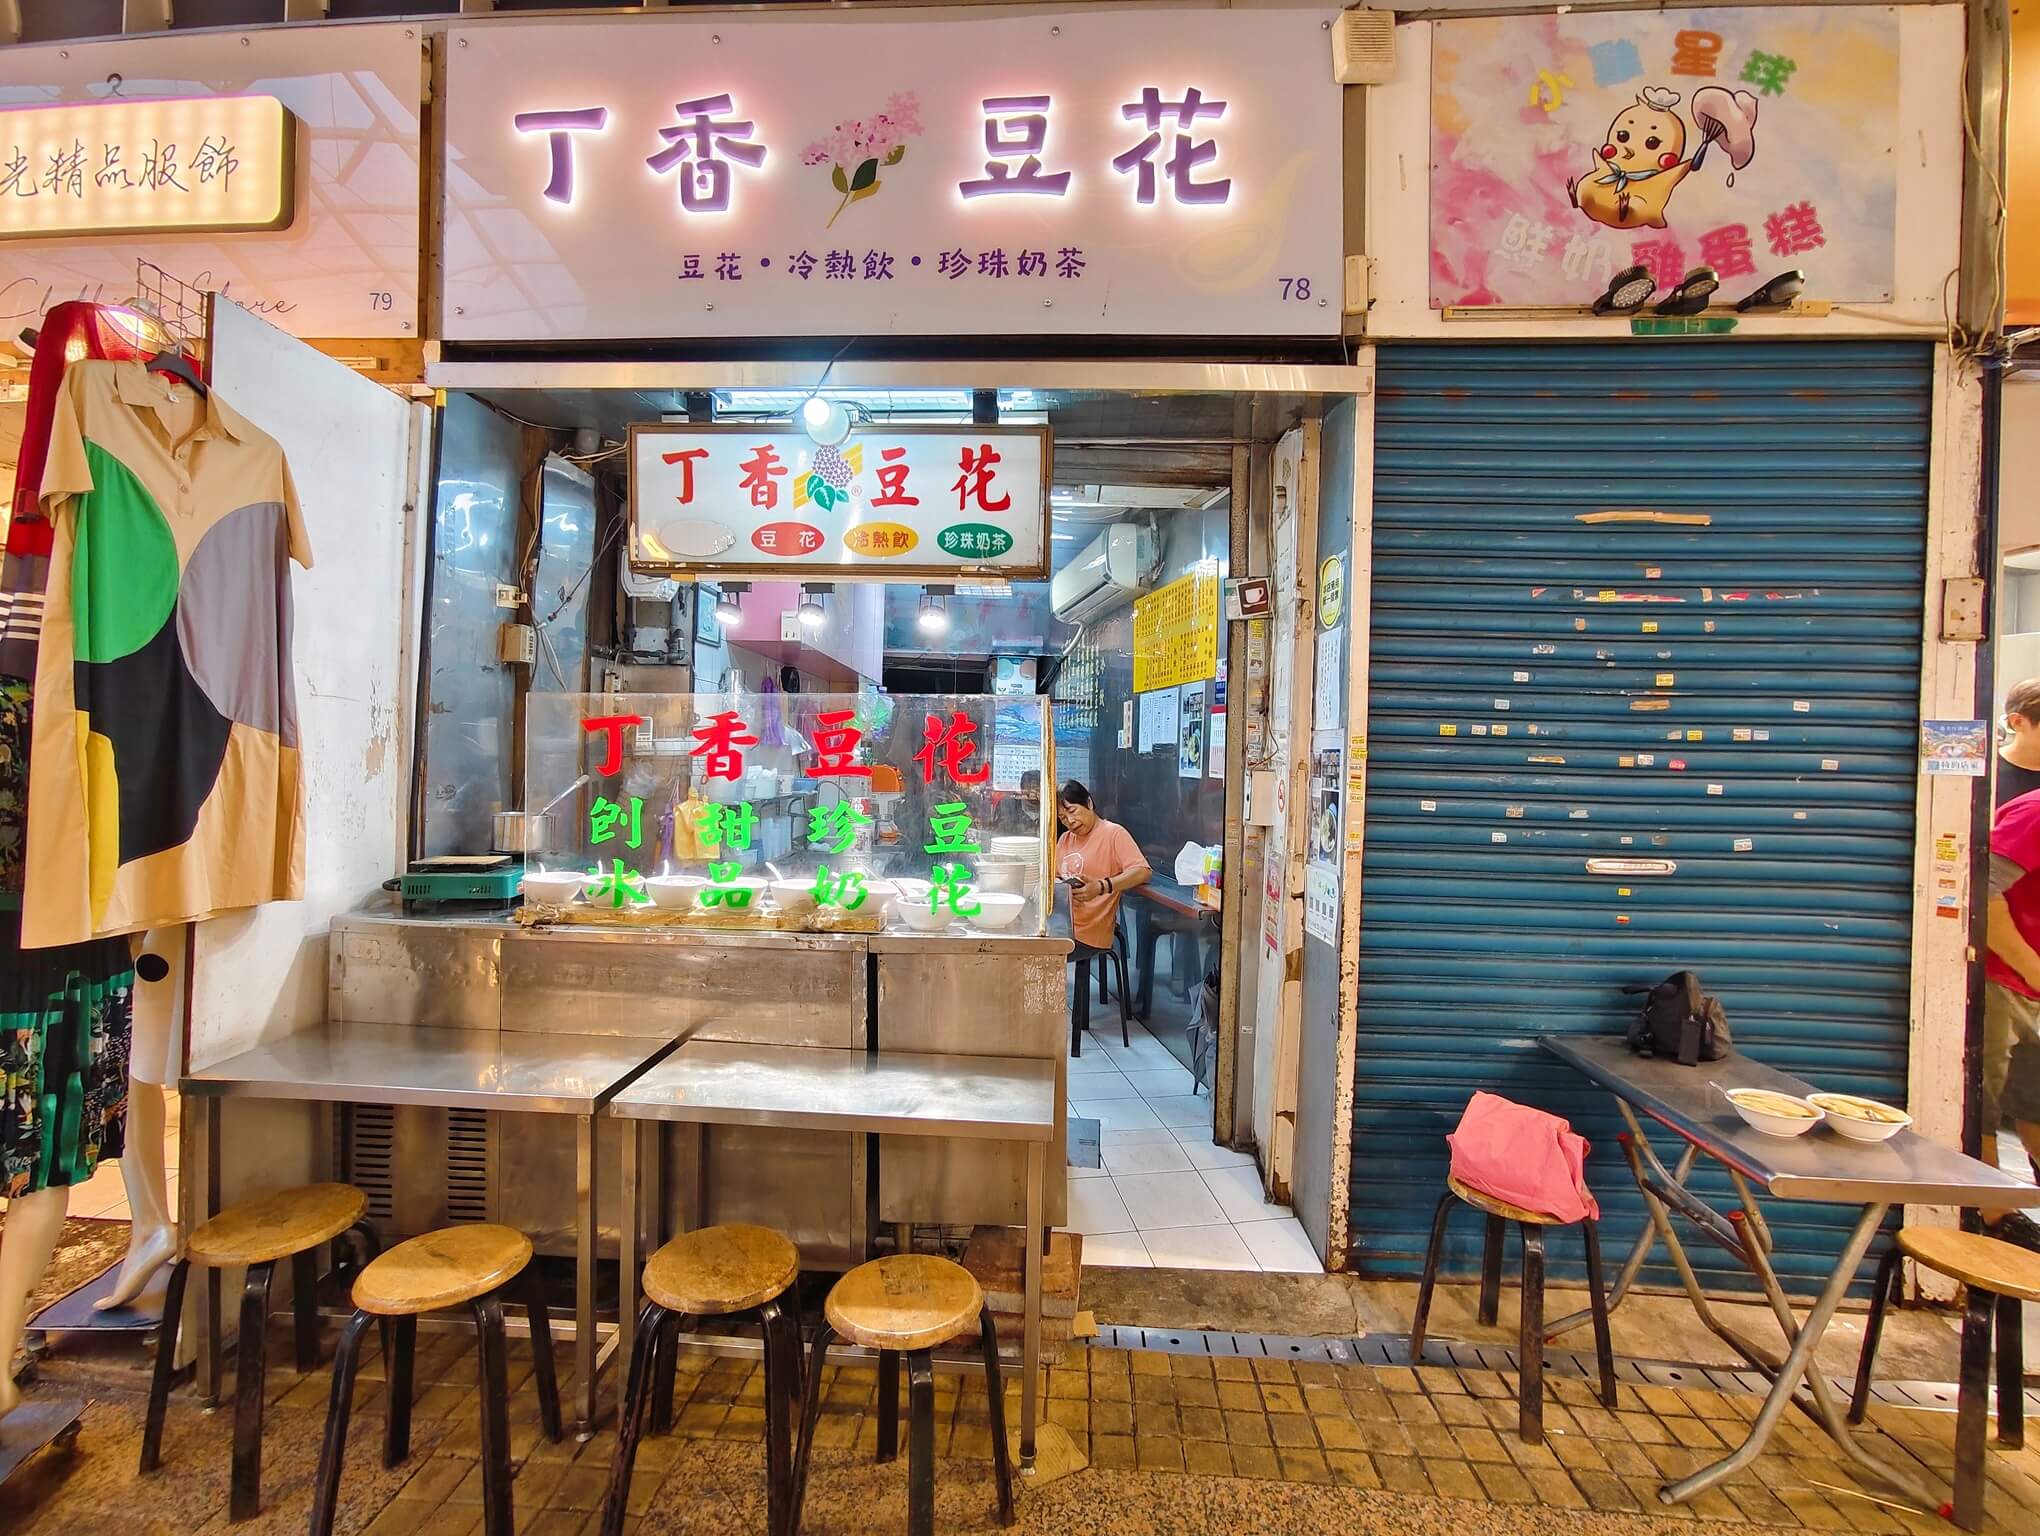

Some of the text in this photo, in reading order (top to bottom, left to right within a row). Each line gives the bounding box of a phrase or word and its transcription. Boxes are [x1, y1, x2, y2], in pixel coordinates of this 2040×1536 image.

[514, 87, 1232, 213] 丁香 豆花
[369, 292, 393, 311] 79
[1278, 277, 1311, 301] 78
[661, 443, 1011, 512] 丁香 豆花
[759, 530, 816, 548] 豆花
[855, 530, 909, 548] 冷熱飲
[944, 530, 1006, 551] 珍珠奶茶
[698, 800, 759, 910] 甜品
[807, 800, 874, 912] 珍奶
[922, 802, 984, 918] 豆花
